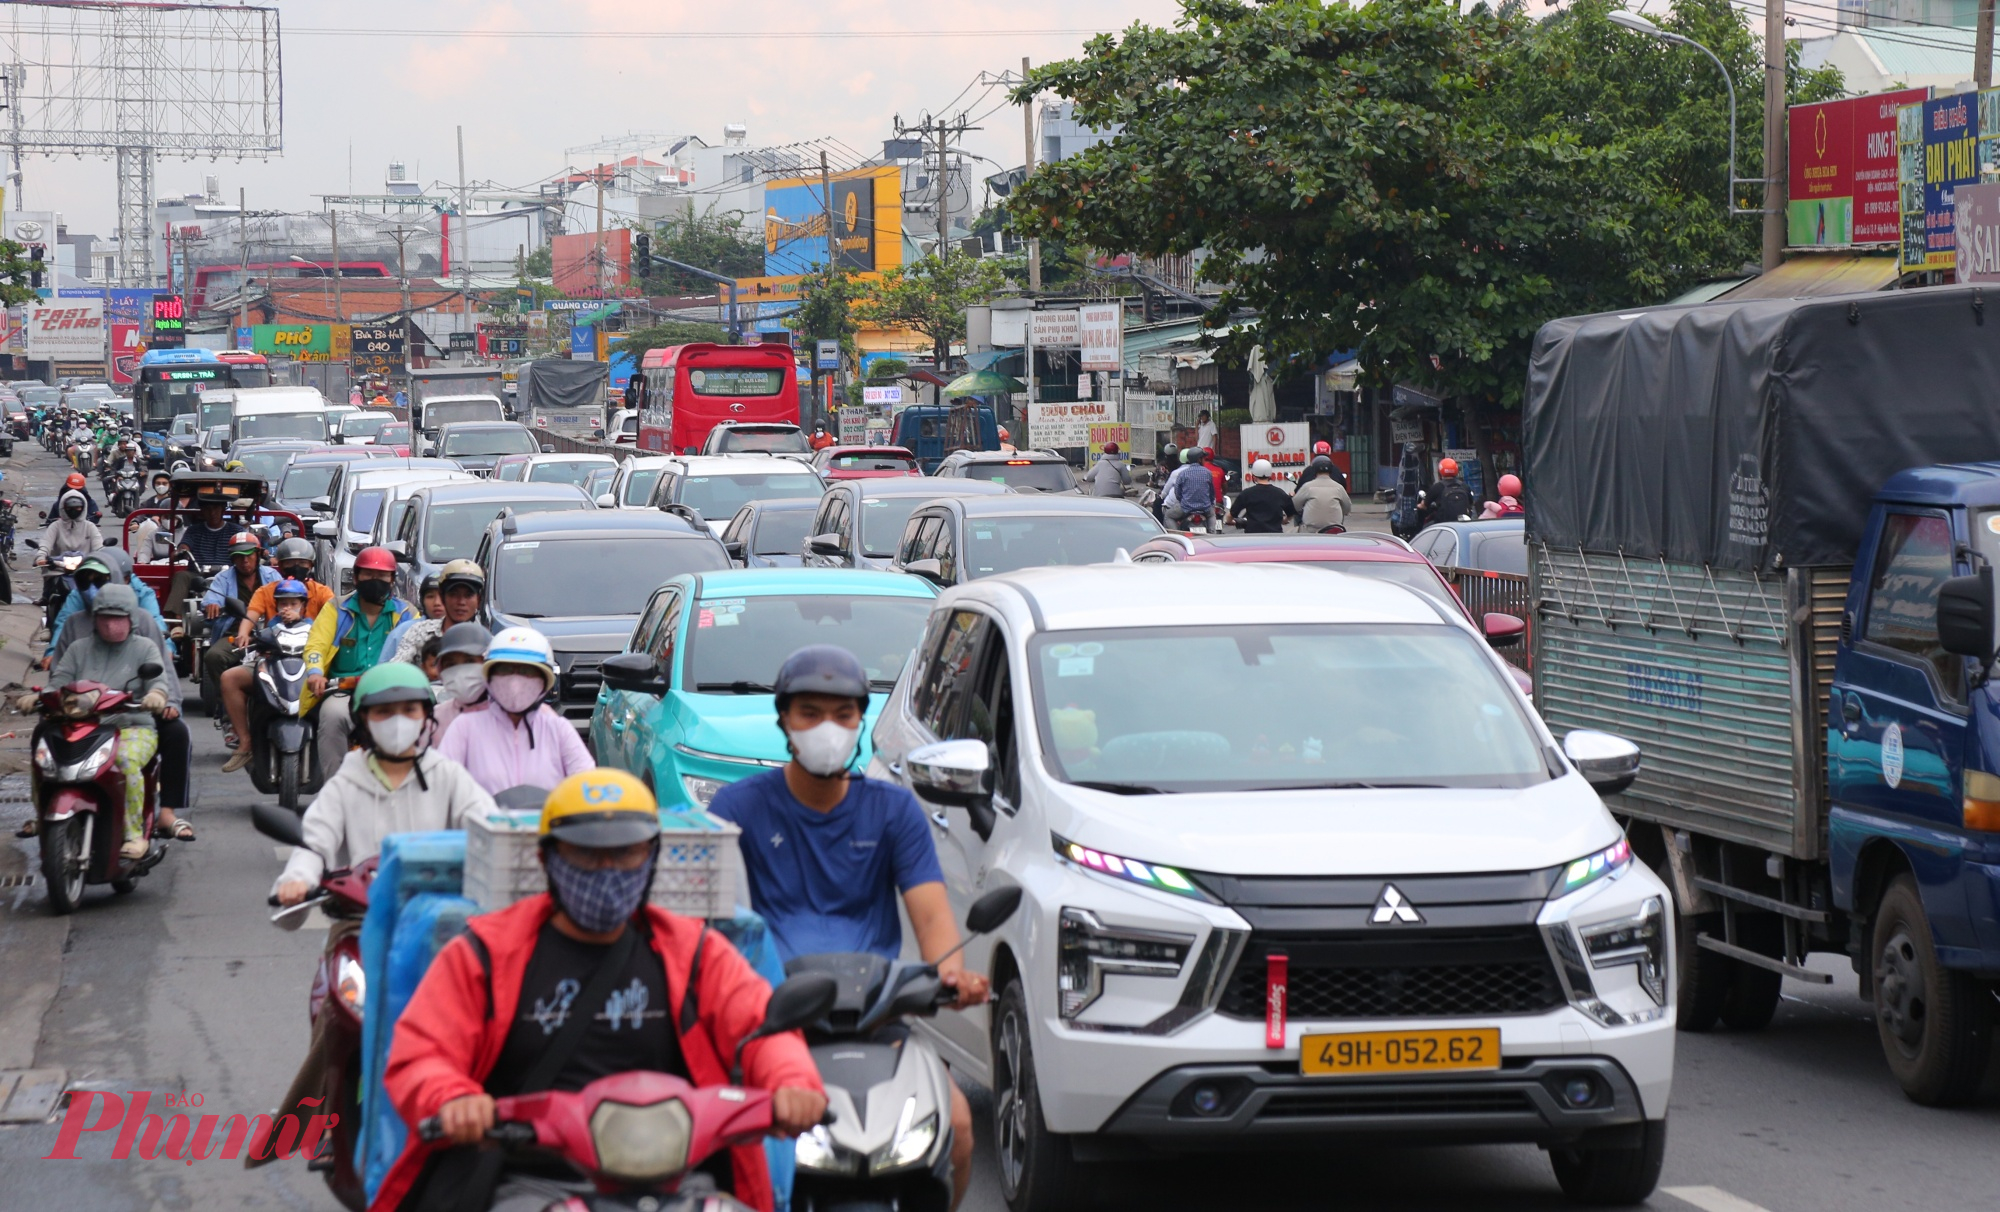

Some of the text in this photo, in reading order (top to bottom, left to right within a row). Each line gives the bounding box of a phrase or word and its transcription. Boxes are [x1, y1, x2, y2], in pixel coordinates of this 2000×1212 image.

[1926, 128, 1976, 191] ĐẠI PHÁT
[155, 296, 182, 319] PHỞ
[552, 301, 599, 310] QUẢNG CÁO
[33, 308, 92, 321] FAST
[1035, 313, 1076, 323] PHÒNG KHÁM
[41, 317, 102, 331] CARS
[1034, 324, 1078, 335] SẢN PHỤ KHOA
[274, 326, 313, 345] PHỞ
[373, 329, 387, 340] Bò
[1040, 335, 1058, 343] SIÊU
[368, 342, 391, 352] 640
[366, 366, 391, 375] 640
[194, 383, 205, 392] 19
[1070, 402, 1105, 415] CHÂU
[1090, 424, 1129, 443] BÚN RIÊU
[1272, 452, 1291, 463] SÀN
[582, 781, 623, 804] be
[1268, 983, 1285, 1040] Supreme
[1319, 1036, 1483, 1067] 49H-052.62
